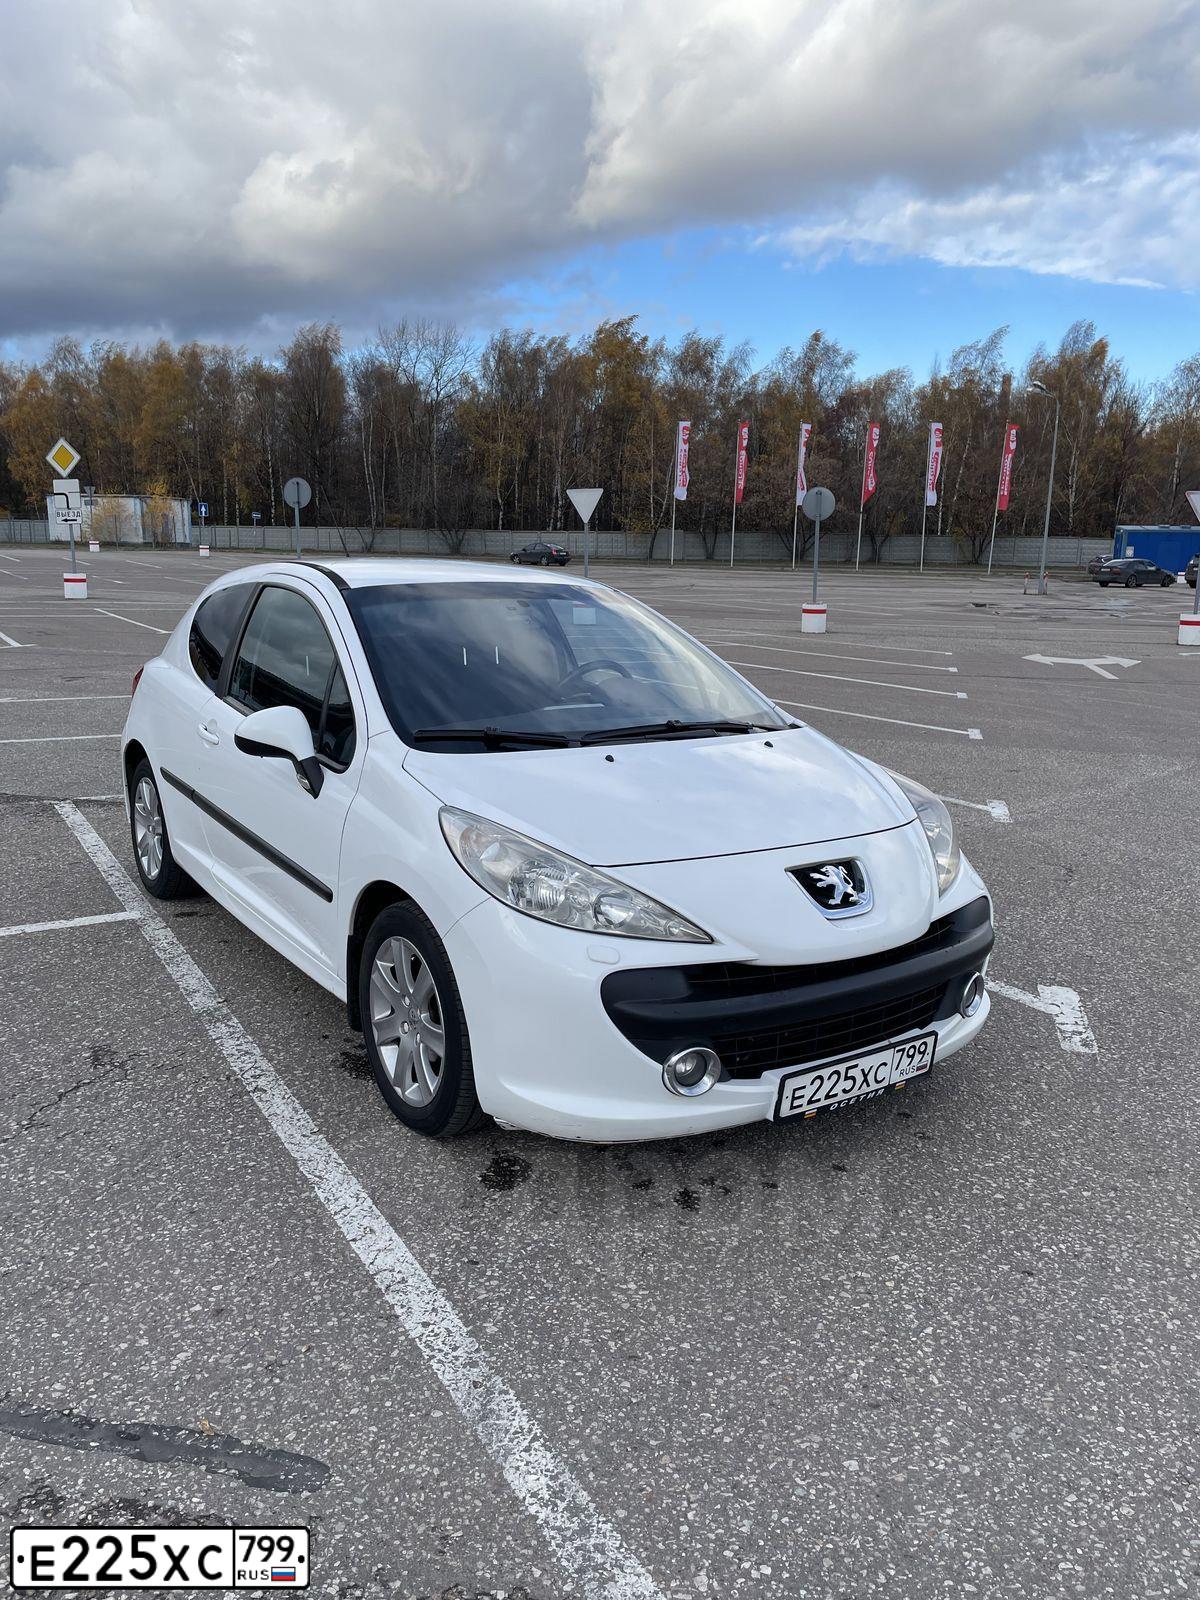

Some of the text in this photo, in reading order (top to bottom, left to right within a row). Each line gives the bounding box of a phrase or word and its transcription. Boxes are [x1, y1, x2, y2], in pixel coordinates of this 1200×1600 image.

[895, 1040, 928, 1072] 799
[900, 1065, 916, 1077] RUS
[829, 1088, 885, 1111] ОСЕТИЯ
